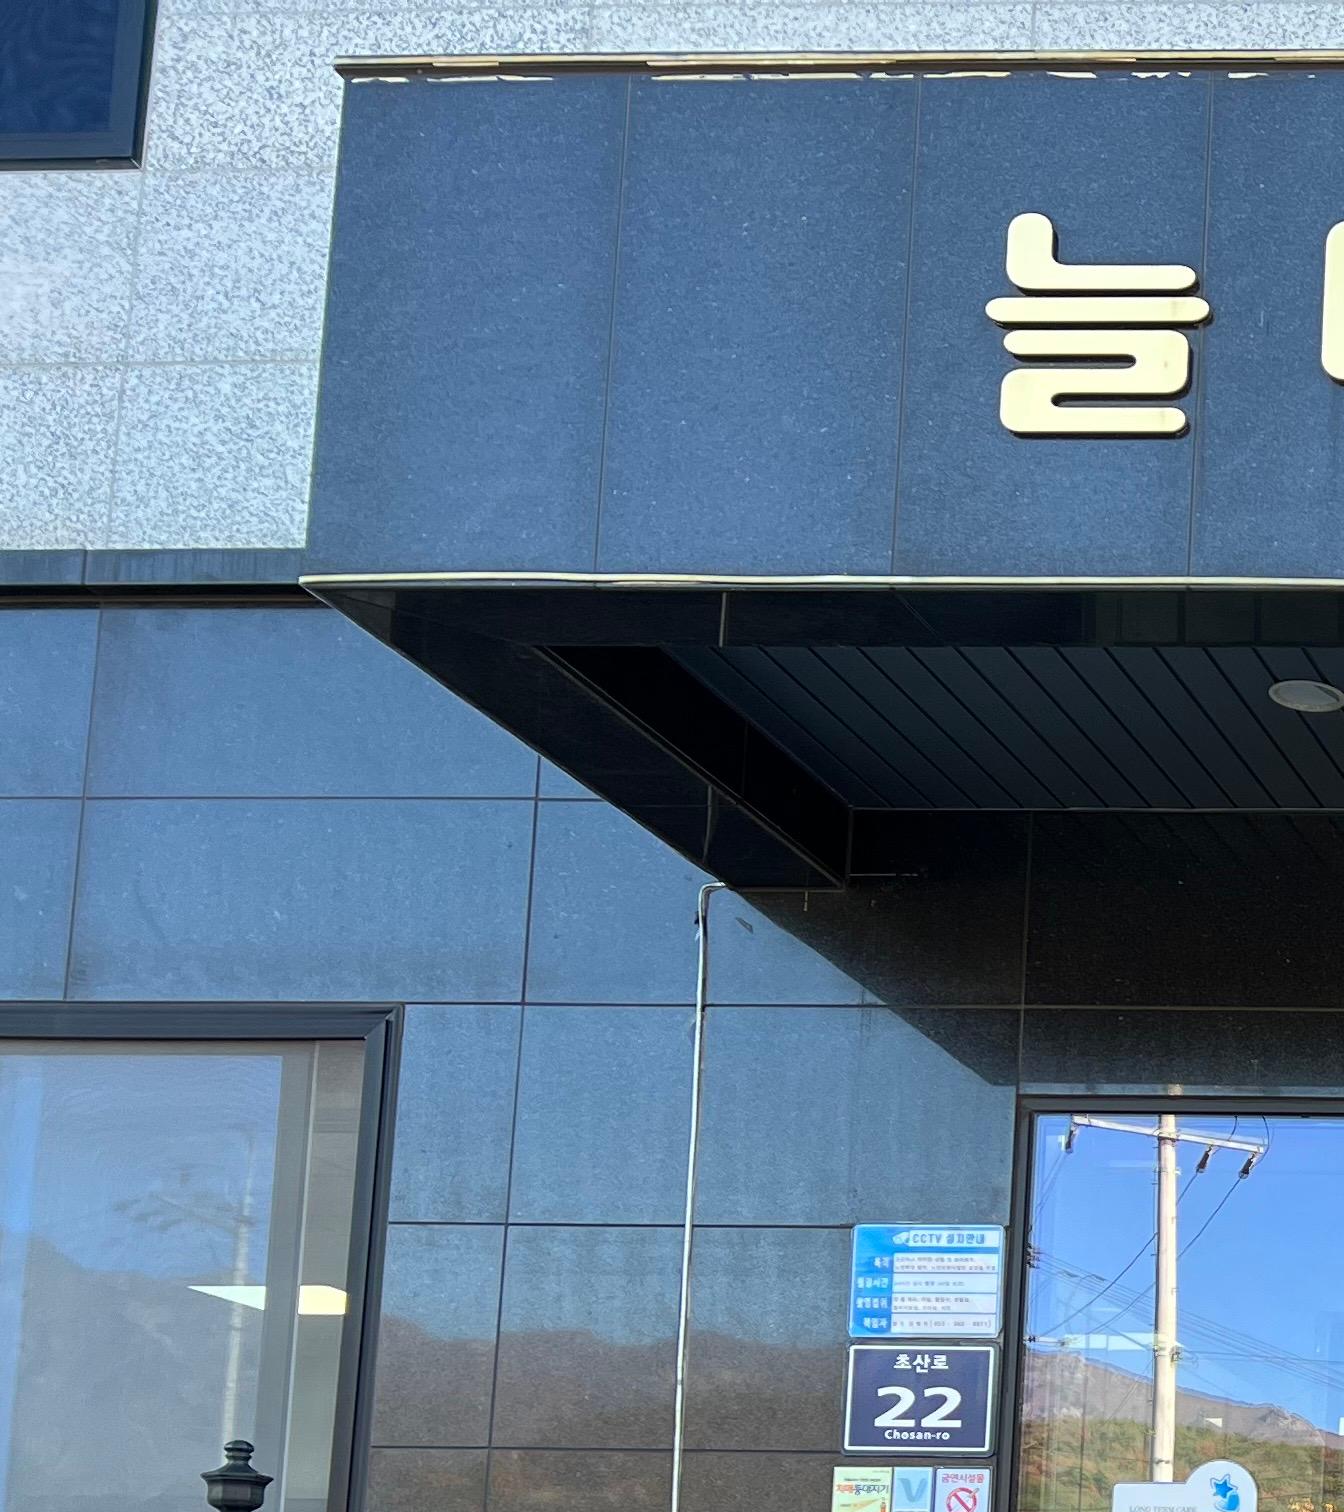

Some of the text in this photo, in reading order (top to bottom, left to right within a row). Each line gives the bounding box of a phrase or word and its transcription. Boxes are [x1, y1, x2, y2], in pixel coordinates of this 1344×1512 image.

[985, 211, 1211, 434] 늘
[912, 1233, 942, 1244] CCTV
[893, 1353, 949, 1373] 초산로
[874, 1386, 962, 1428] 22
[884, 1429, 950, 1440] Chosan-ro
[1129, 1505, 1150, 1512] LONG
